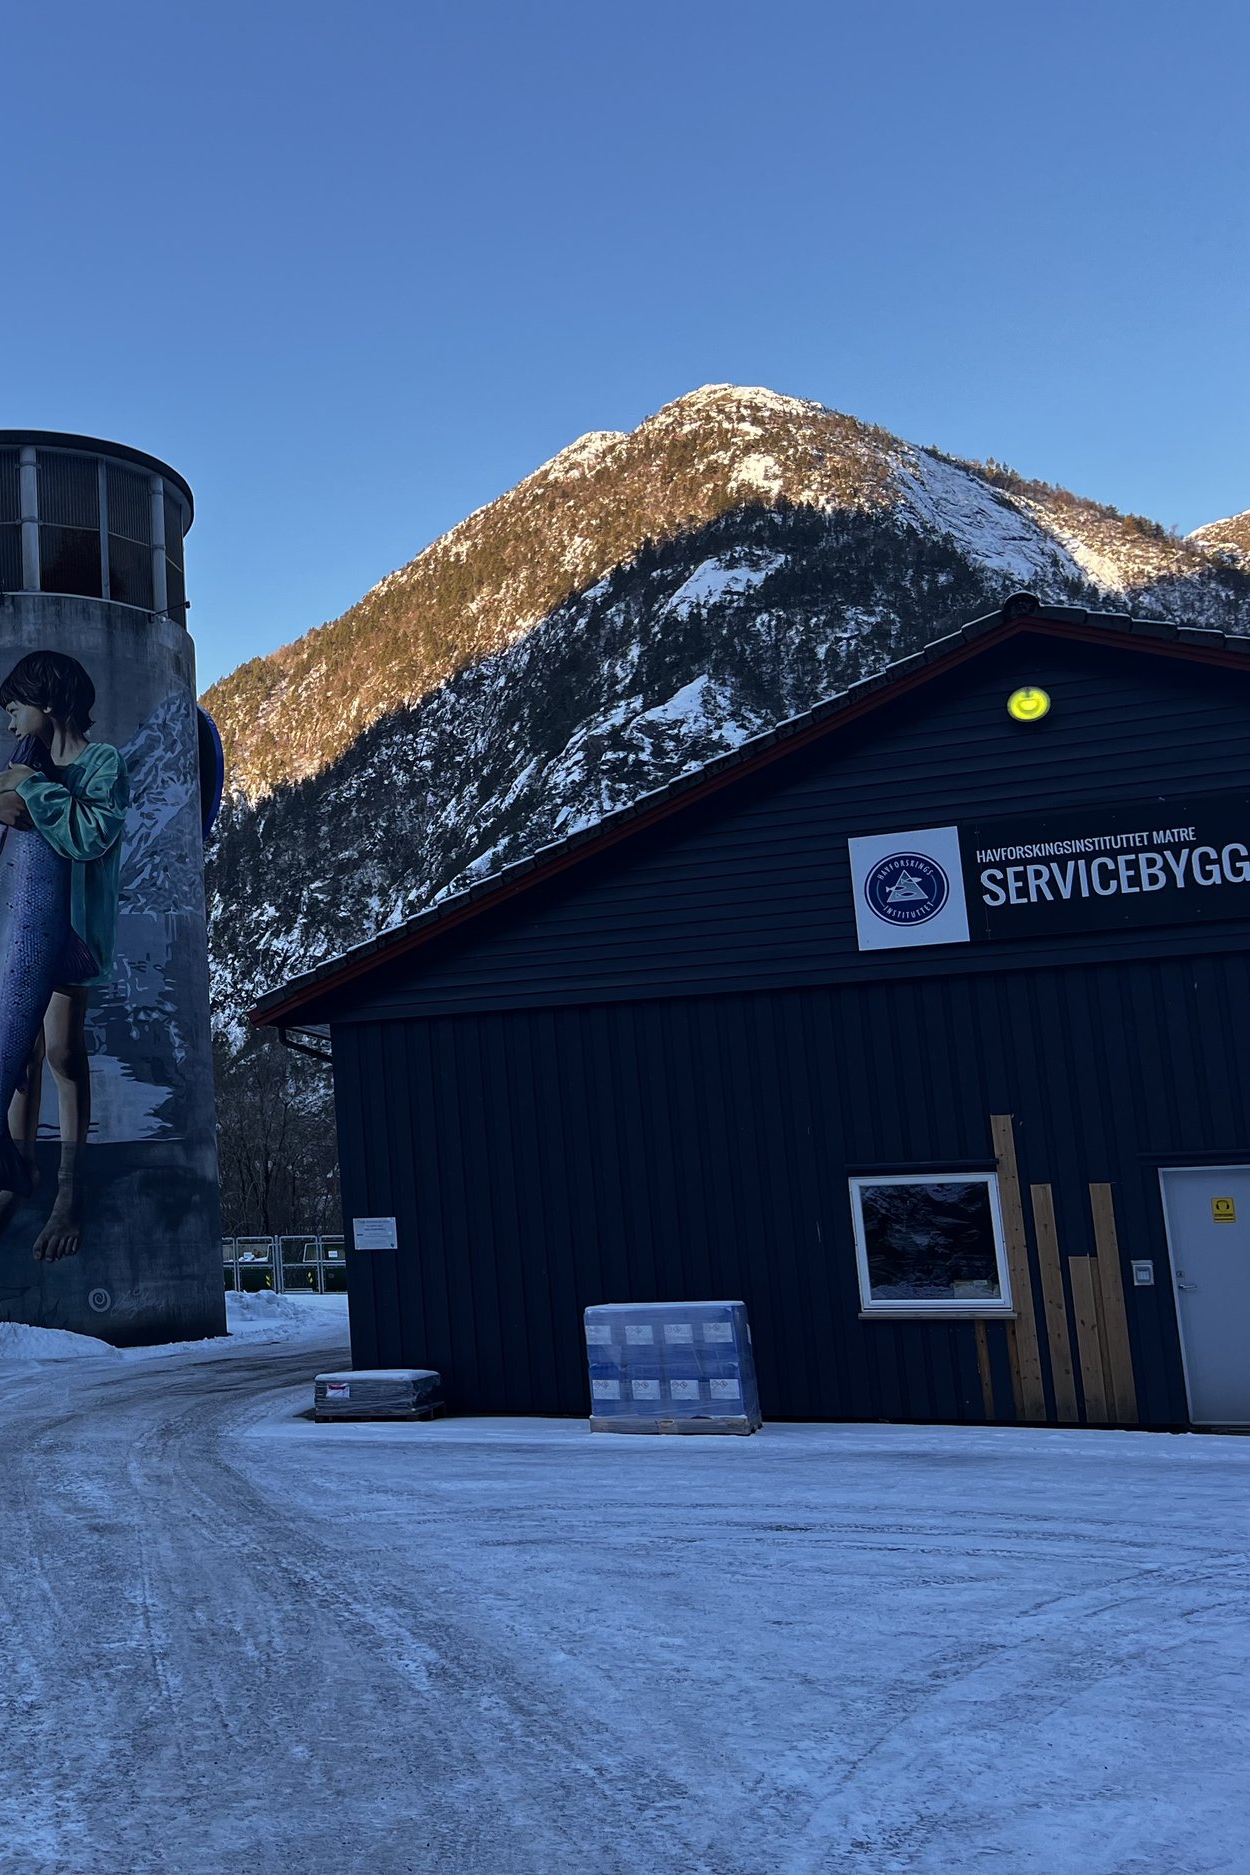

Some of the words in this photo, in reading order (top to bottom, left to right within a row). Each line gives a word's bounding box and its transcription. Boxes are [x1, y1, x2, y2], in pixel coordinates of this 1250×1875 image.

[976, 832, 1149, 863] HAVFORSKINGSINSTITUTTET
[1152, 827, 1197, 845] MATRE
[877, 860, 934, 880] HAVFORSKINGS
[980, 843, 1250, 907] SERVICEBYGG
[883, 901, 934, 919] INSTITUTTET
